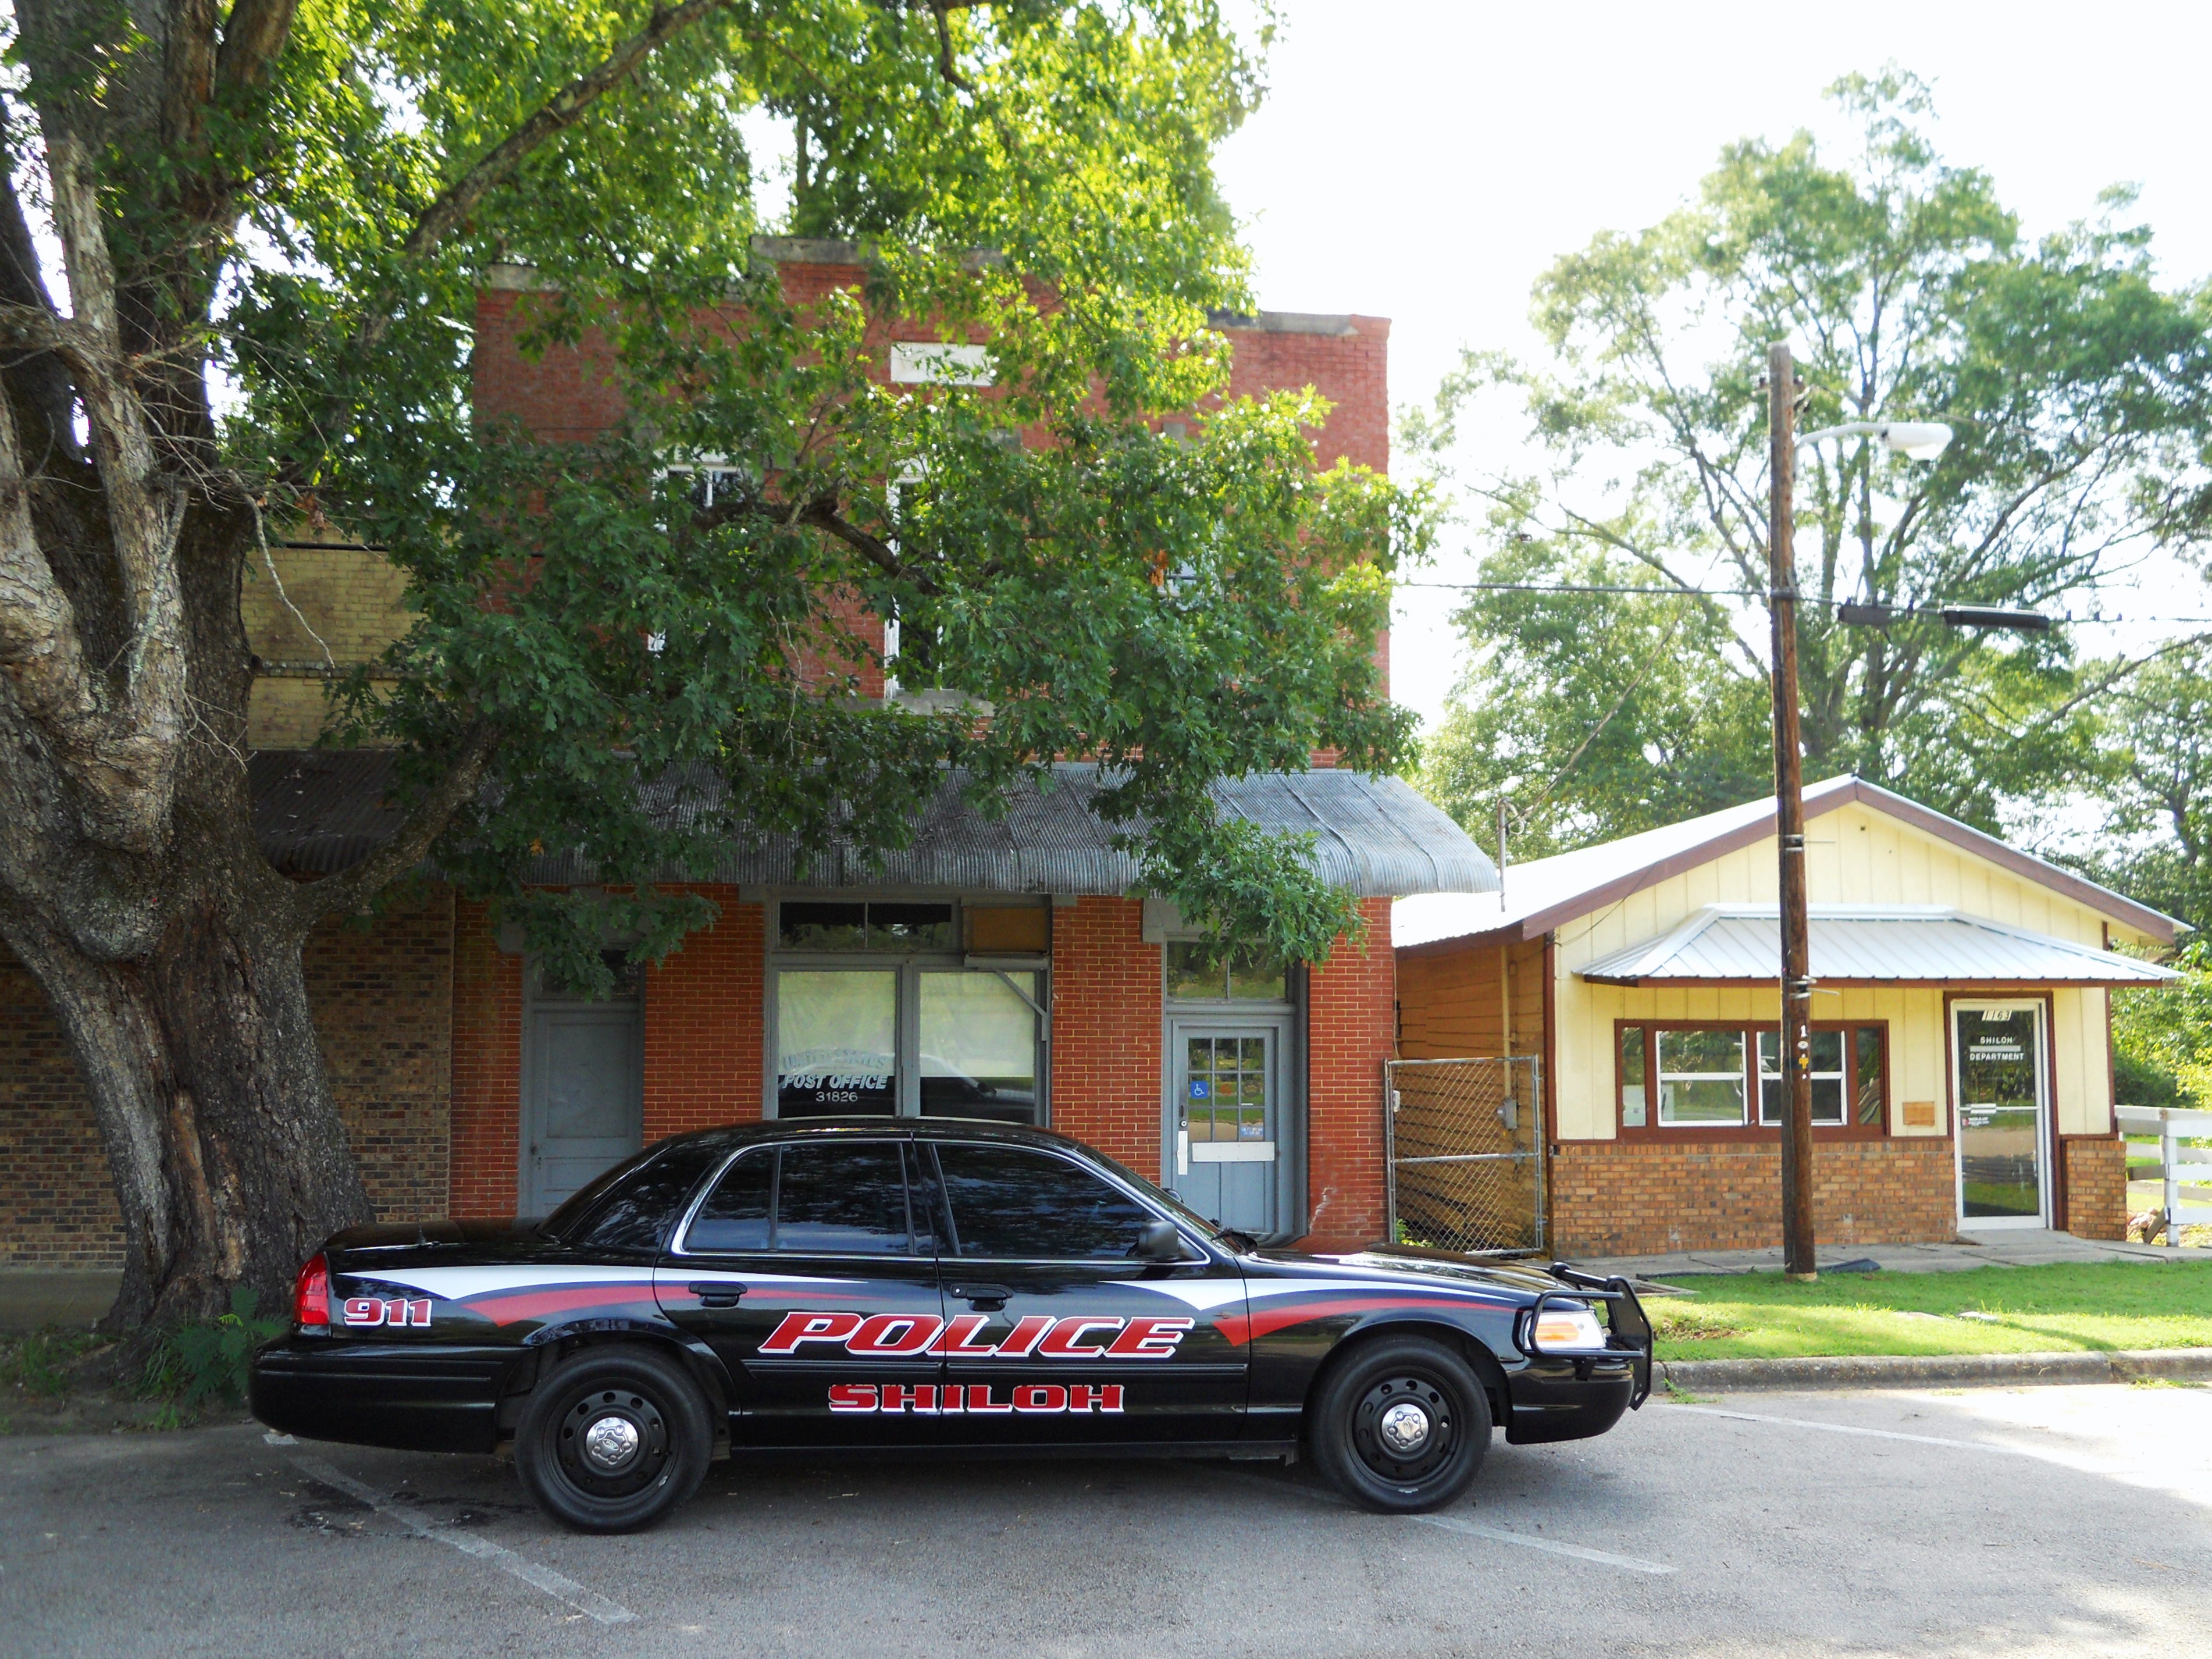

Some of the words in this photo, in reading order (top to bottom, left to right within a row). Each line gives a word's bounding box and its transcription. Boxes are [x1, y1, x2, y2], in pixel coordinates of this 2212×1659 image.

[1983, 1010, 2011, 1020] 1163
[1980, 1036, 2013, 1045] SHILOH
[1969, 1052, 2024, 1060] DEPARTMENT
[782, 1074, 827, 1089] POST
[829, 1074, 888, 1090] OFFICE
[815, 1091, 858, 1102] 31826
[344, 1297, 432, 1327] 911
[757, 1311, 1195, 1358] POLICE
[828, 1384, 1125, 1412] SHILOH
